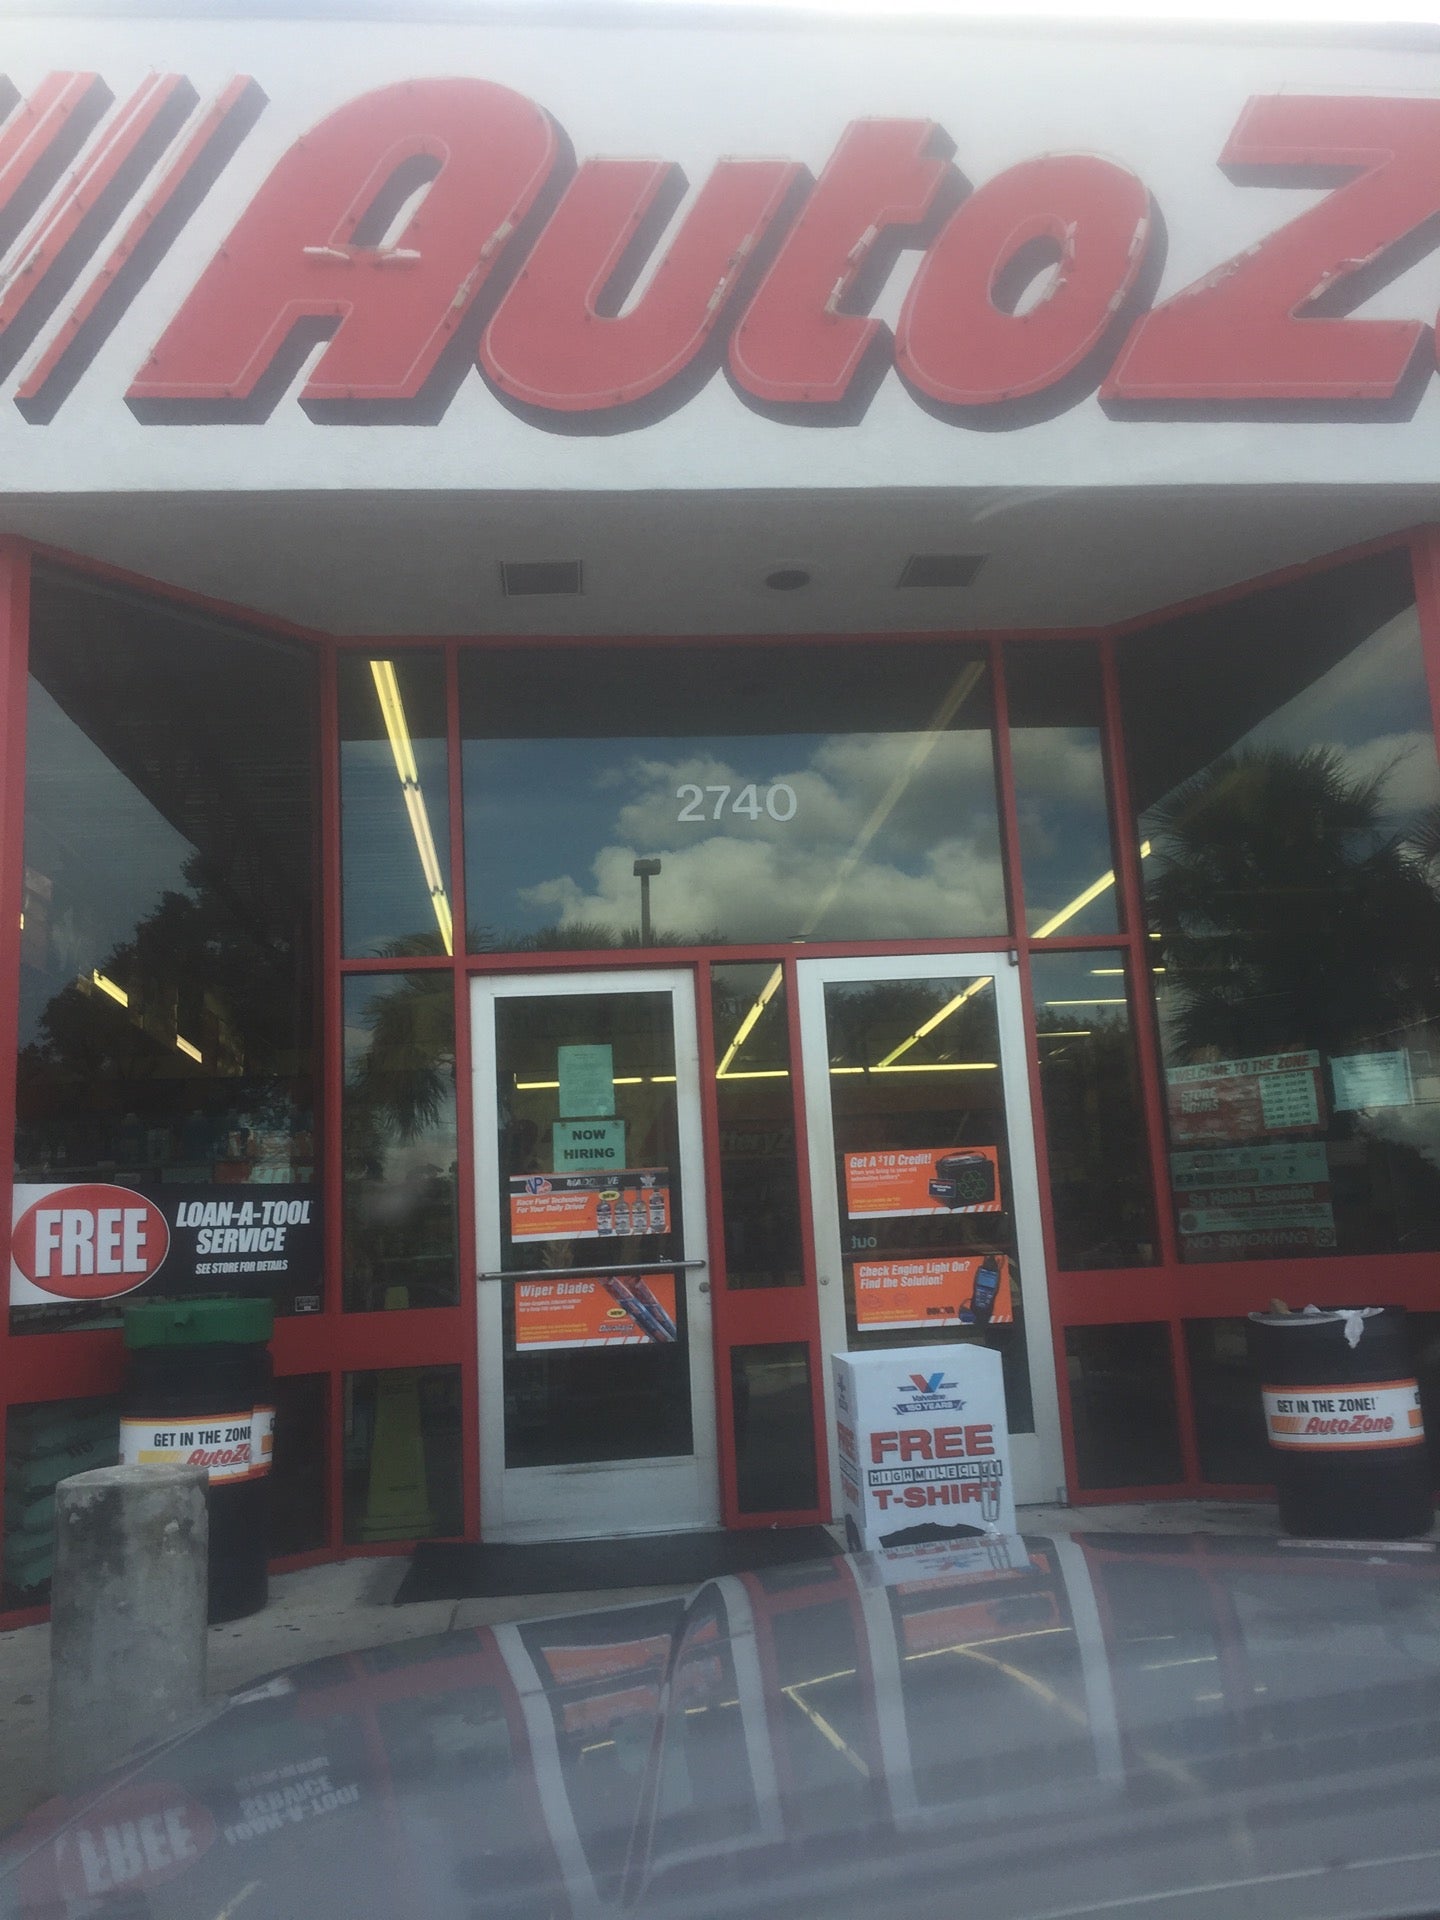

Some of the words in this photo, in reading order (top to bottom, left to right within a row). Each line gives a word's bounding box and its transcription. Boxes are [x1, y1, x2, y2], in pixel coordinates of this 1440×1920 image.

[124, 76, 1440, 432] AutoZ
[676, 783, 798, 822] 2740
[1174, 1063, 1233, 1081] WELCOME
[1234, 1061, 1249, 1075] TO
[1252, 1058, 1274, 1072] THE
[1277, 1054, 1310, 1068] ZONE
[572, 1129, 606, 1141] NOW
[563, 1147, 615, 1160] HIRING
[850, 1156, 867, 1168] Get
[869, 1156, 879, 1167] A
[897, 1153, 932, 1165] Credit!
[176, 1201, 311, 1227] LOAN-A-TOOL
[35, 1209, 148, 1277] FREE
[196, 1227, 286, 1254] SERVICE
[195, 1264, 212, 1275] SEE
[212, 1262, 239, 1273] STORE
[240, 1261, 256, 1272] FOR
[257, 1259, 288, 1271] DETAILS
[859, 1266, 889, 1277] Check
[891, 1264, 924, 1276] Engine
[926, 1261, 949, 1274] Light
[952, 1261, 970, 1272] On?
[519, 1285, 553, 1297] Wiper
[556, 1282, 595, 1295] Blades
[860, 1277, 881, 1289] Find
[883, 1276, 899, 1287] the
[900, 1275, 944, 1287] Solution!
[923, 1402, 953, 1410] YEARS
[1278, 1400, 1294, 1413] GET
[1297, 1400, 1310, 1413] IN
[1313, 1399, 1335, 1412] THE
[1339, 1397, 1375, 1412] ZONE!
[1305, 1414, 1393, 1435] AutoZone
[154, 1433, 176, 1447] GET
[180, 1432, 194, 1446] IN
[198, 1430, 221, 1444] THE
[870, 1424, 995, 1464] FREE
